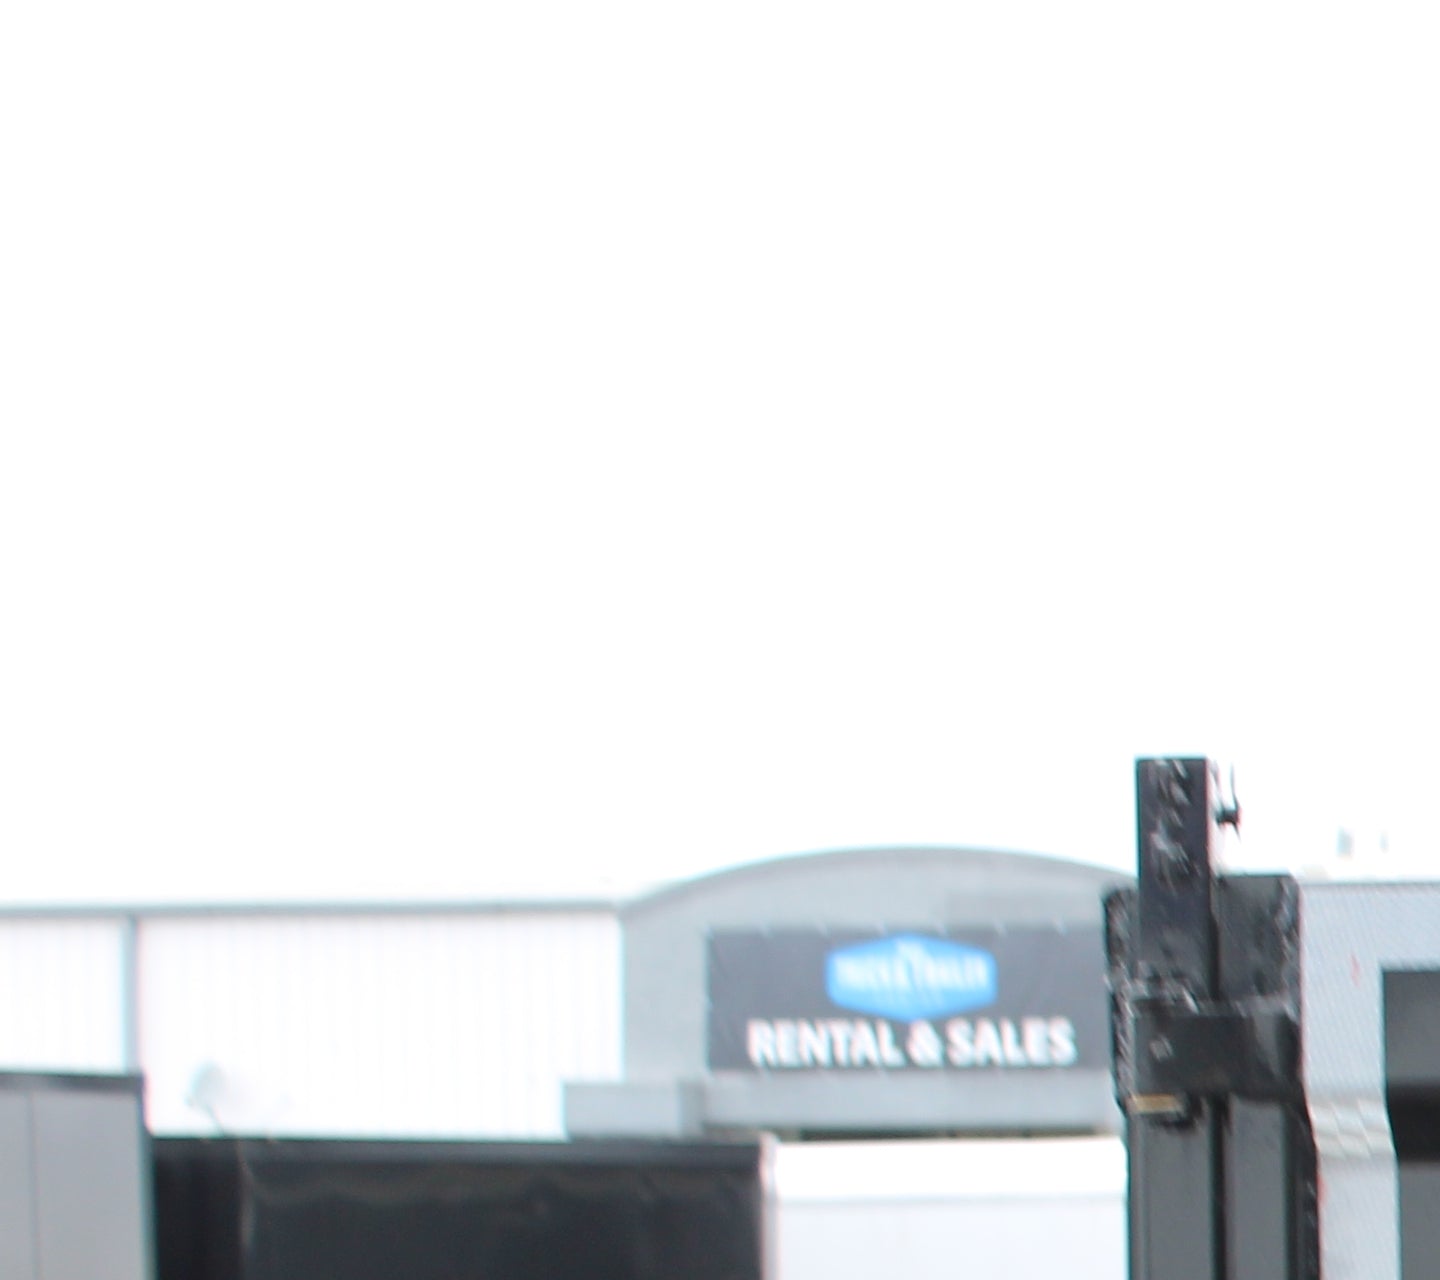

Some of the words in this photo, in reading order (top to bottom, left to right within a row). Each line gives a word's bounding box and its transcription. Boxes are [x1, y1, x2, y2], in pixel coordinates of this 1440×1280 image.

[747, 1017, 905, 1068] RENTAL
[907, 1017, 943, 1067] &
[946, 1016, 1078, 1067] SALES
